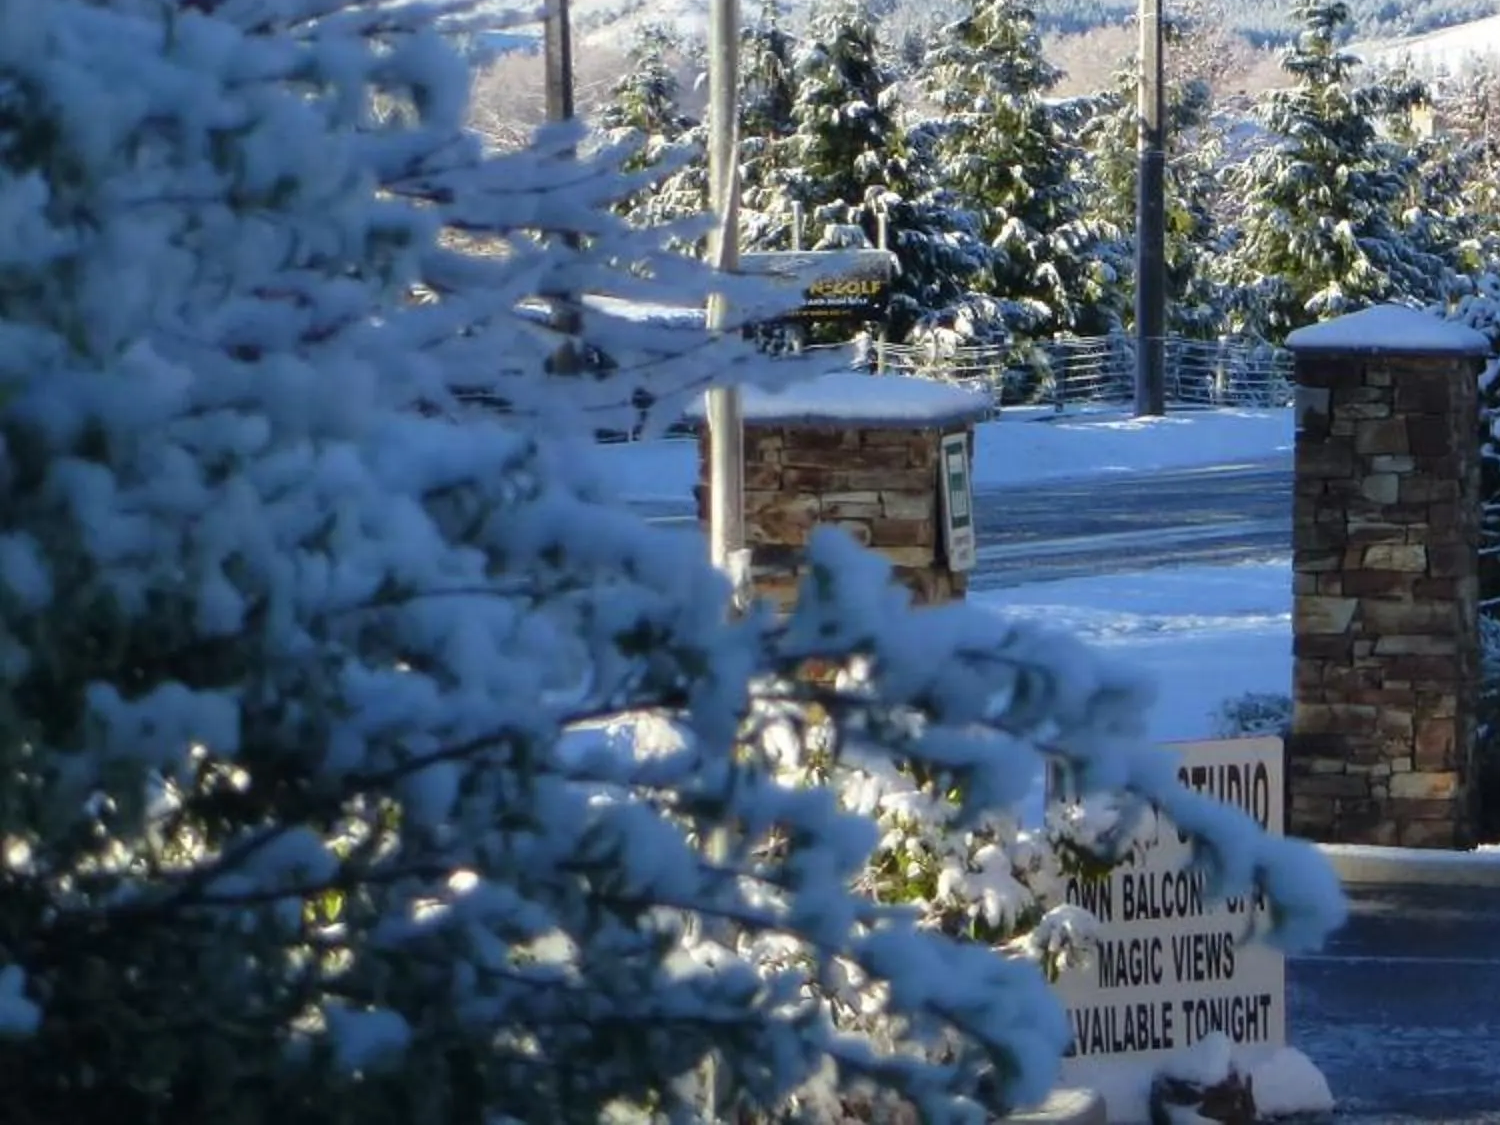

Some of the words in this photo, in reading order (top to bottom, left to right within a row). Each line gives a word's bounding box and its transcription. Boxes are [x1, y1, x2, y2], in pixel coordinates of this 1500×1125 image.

[1123, 869, 1204, 921] BALCON
[1098, 935, 1163, 988] MAGIC
[1172, 932, 1235, 982] VIEWS
[1182, 993, 1272, 1047] TONIGHT
